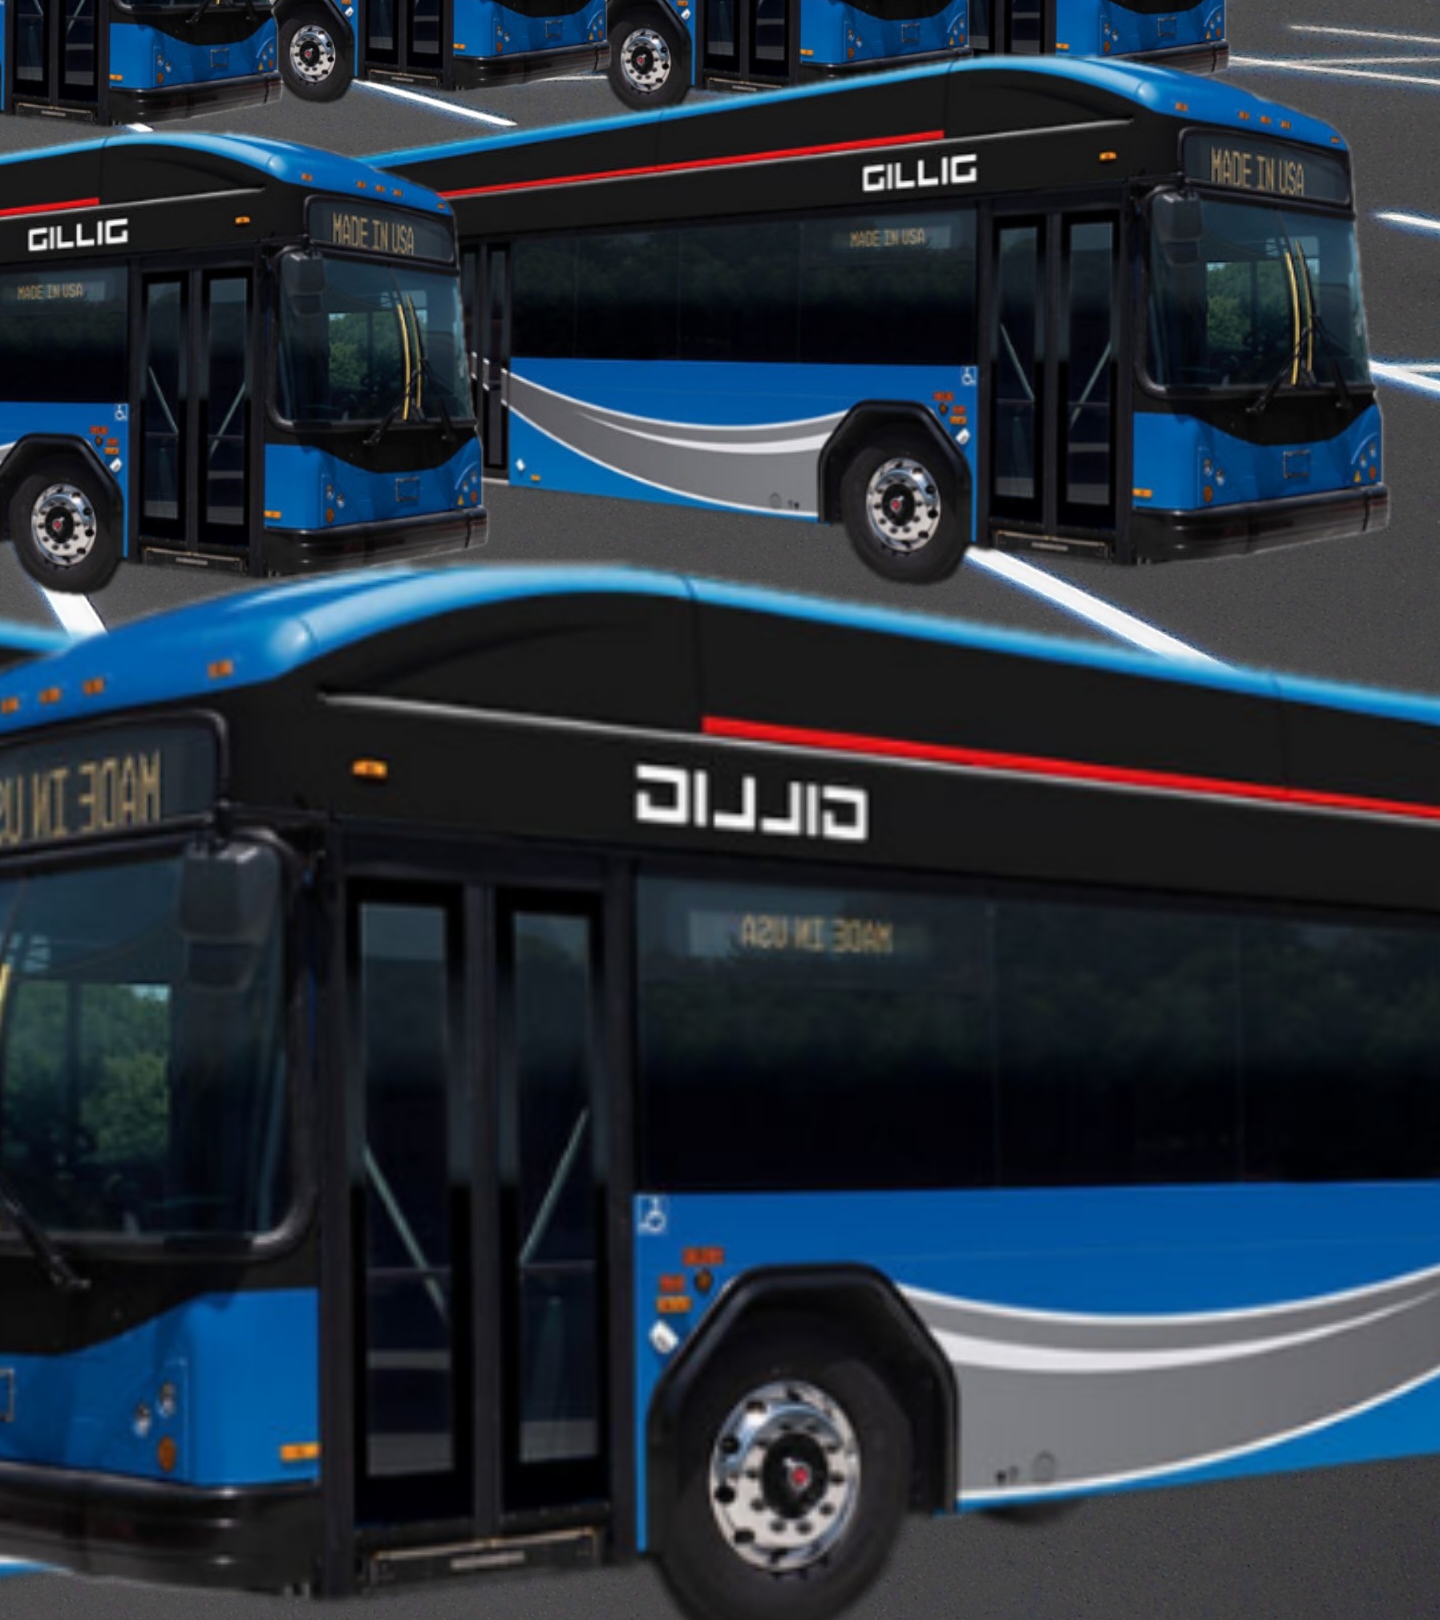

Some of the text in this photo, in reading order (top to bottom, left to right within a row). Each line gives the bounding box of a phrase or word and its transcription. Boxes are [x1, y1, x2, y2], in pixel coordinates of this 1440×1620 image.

[862, 153, 977, 192] GILLIG
[1211, 150, 1304, 195] MADE IN USA
[27, 218, 129, 252] GILLIG
[332, 215, 414, 254] MADE IN USA
